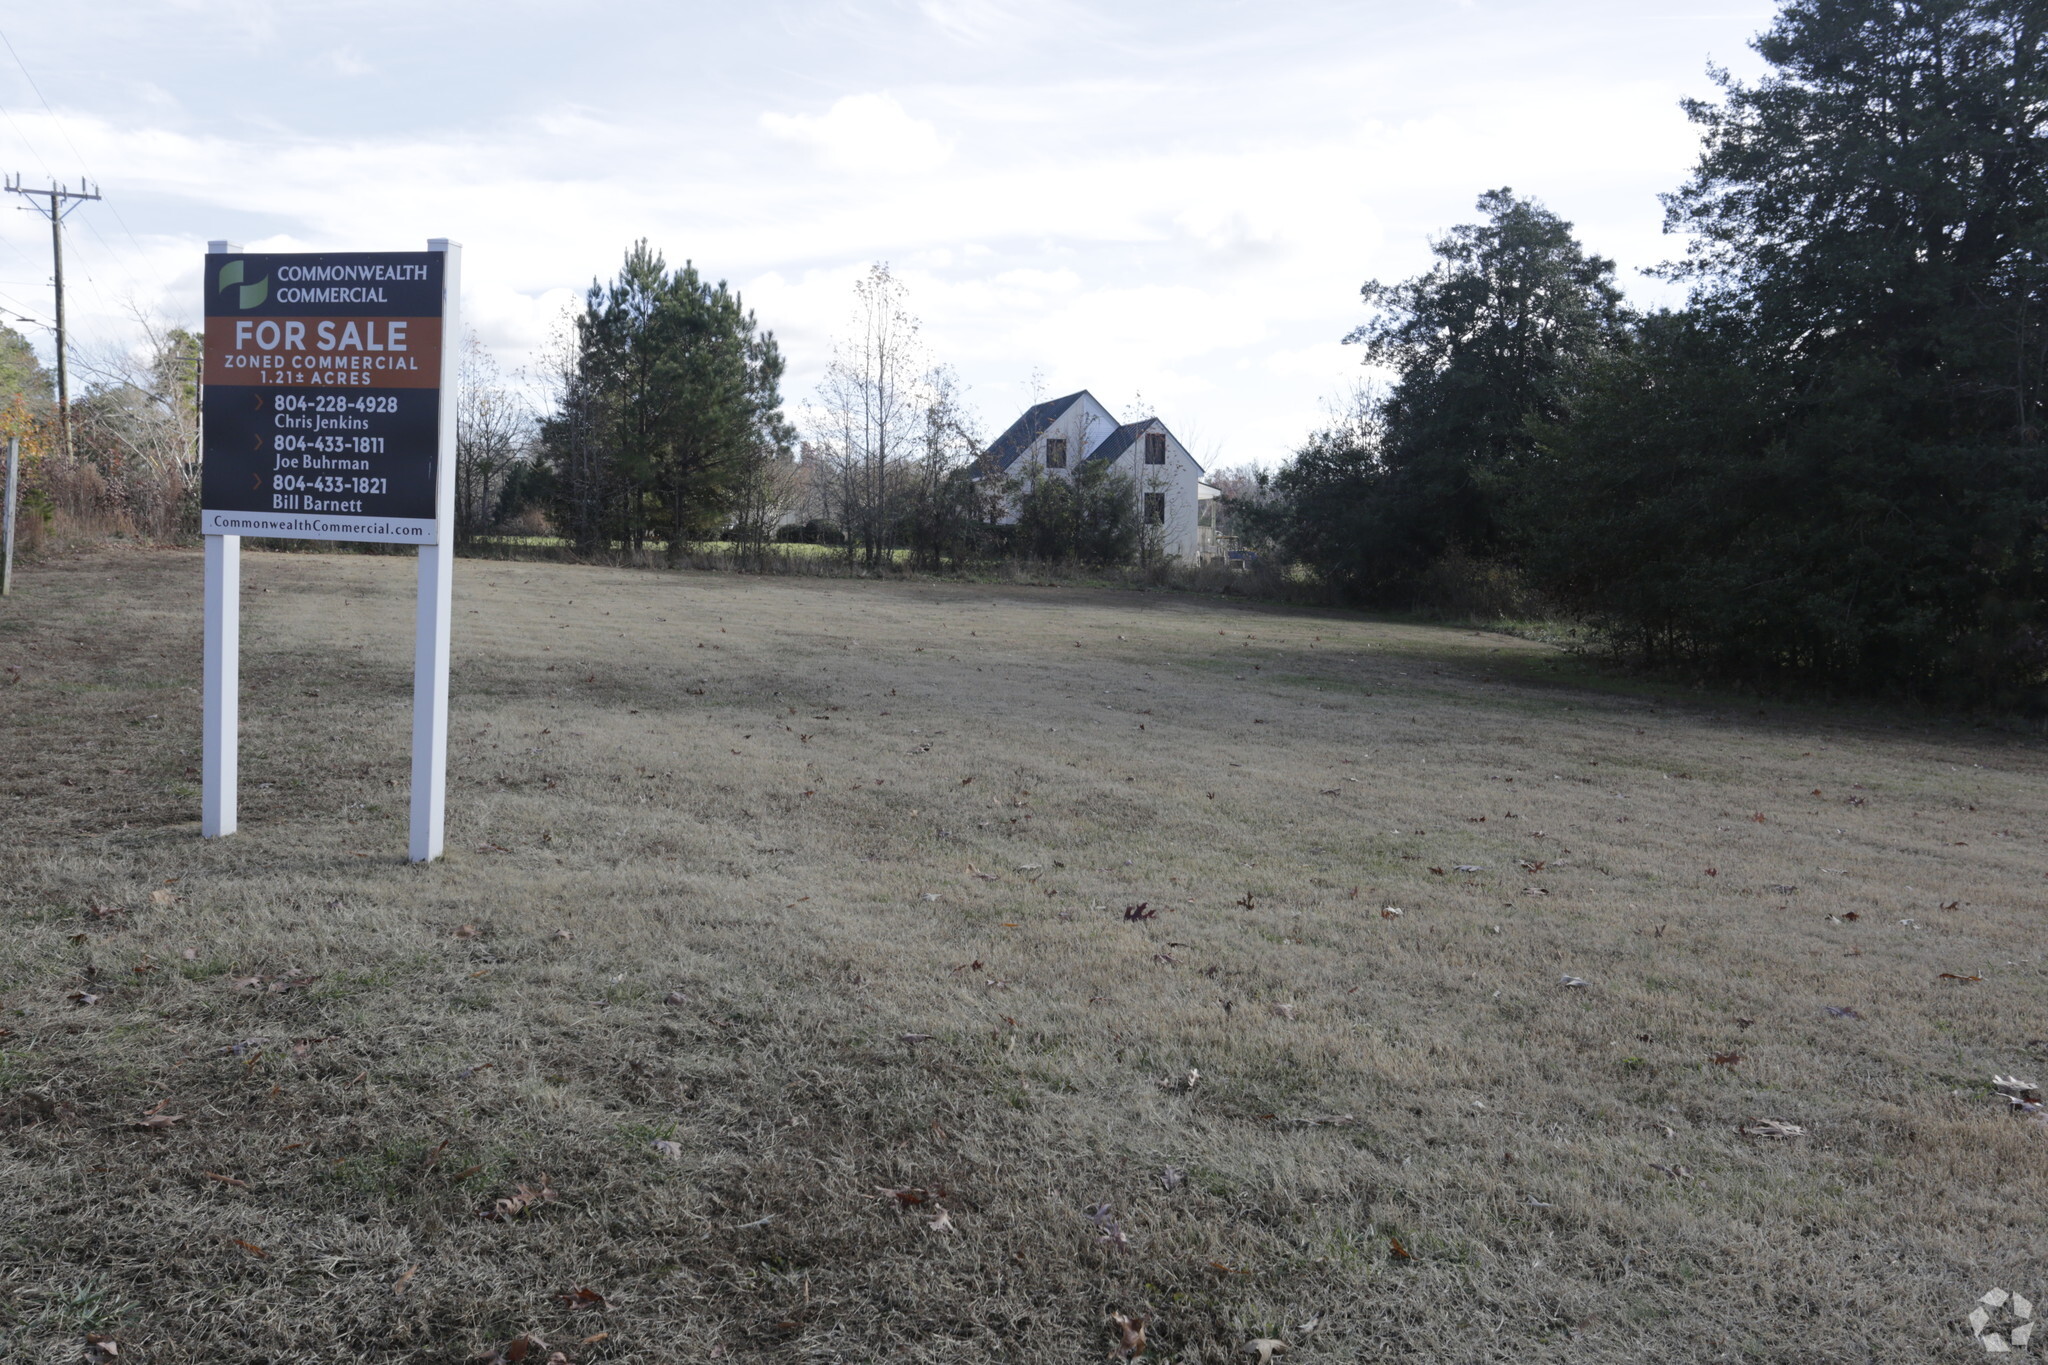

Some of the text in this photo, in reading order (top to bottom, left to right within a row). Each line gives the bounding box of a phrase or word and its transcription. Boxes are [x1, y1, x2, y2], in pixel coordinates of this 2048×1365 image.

[278, 265, 427, 282] COMMONWEALTH
[277, 287, 387, 303] COMMERCIAL
[236, 321, 408, 351] FOR SALE
[225, 355, 418, 370] ZONED COMMERCIAL
[261, 371, 371, 385] 1.21± ACRES
[275, 395, 397, 413] 804-228-4928
[274, 414, 369, 432] Chris Jenkins
[274, 435, 384, 454] 804-433-1811
[274, 454, 369, 470] Joe Buhrman
[273, 475, 387, 494] 804-433-1821
[273, 495, 362, 513] Bill Barnett
[214, 516, 423, 536] CommonwealthCommercial.com
